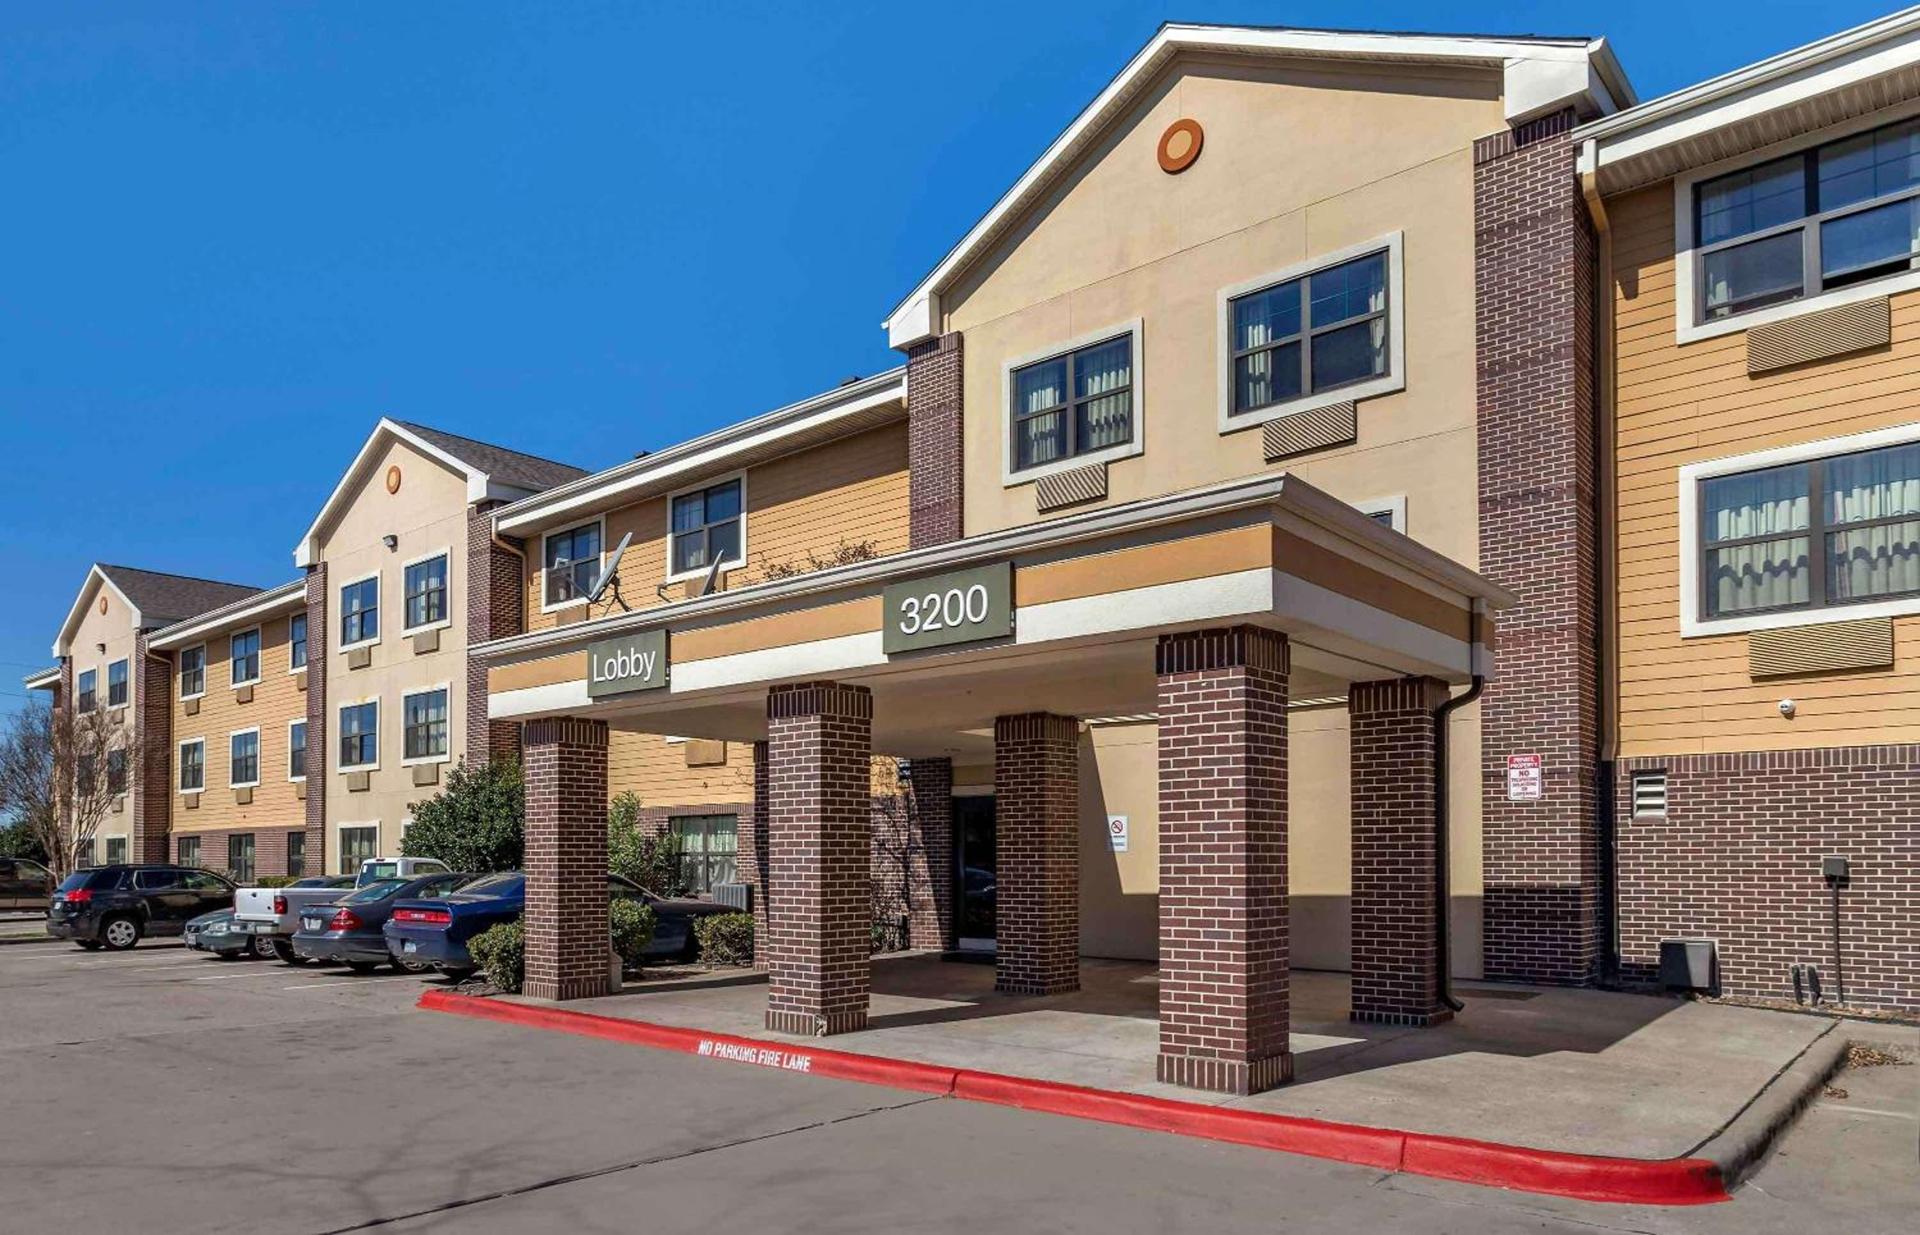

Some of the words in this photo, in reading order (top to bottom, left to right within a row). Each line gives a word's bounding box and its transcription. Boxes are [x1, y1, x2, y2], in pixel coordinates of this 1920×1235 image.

[899, 584, 988, 635] 3200
[593, 647, 656, 683] Lobby
[697, 1039, 713, 1056] NO
[713, 1042, 757, 1063] PARKING
[757, 1049, 782, 1067] FIRE
[782, 1052, 811, 1072] LANE
